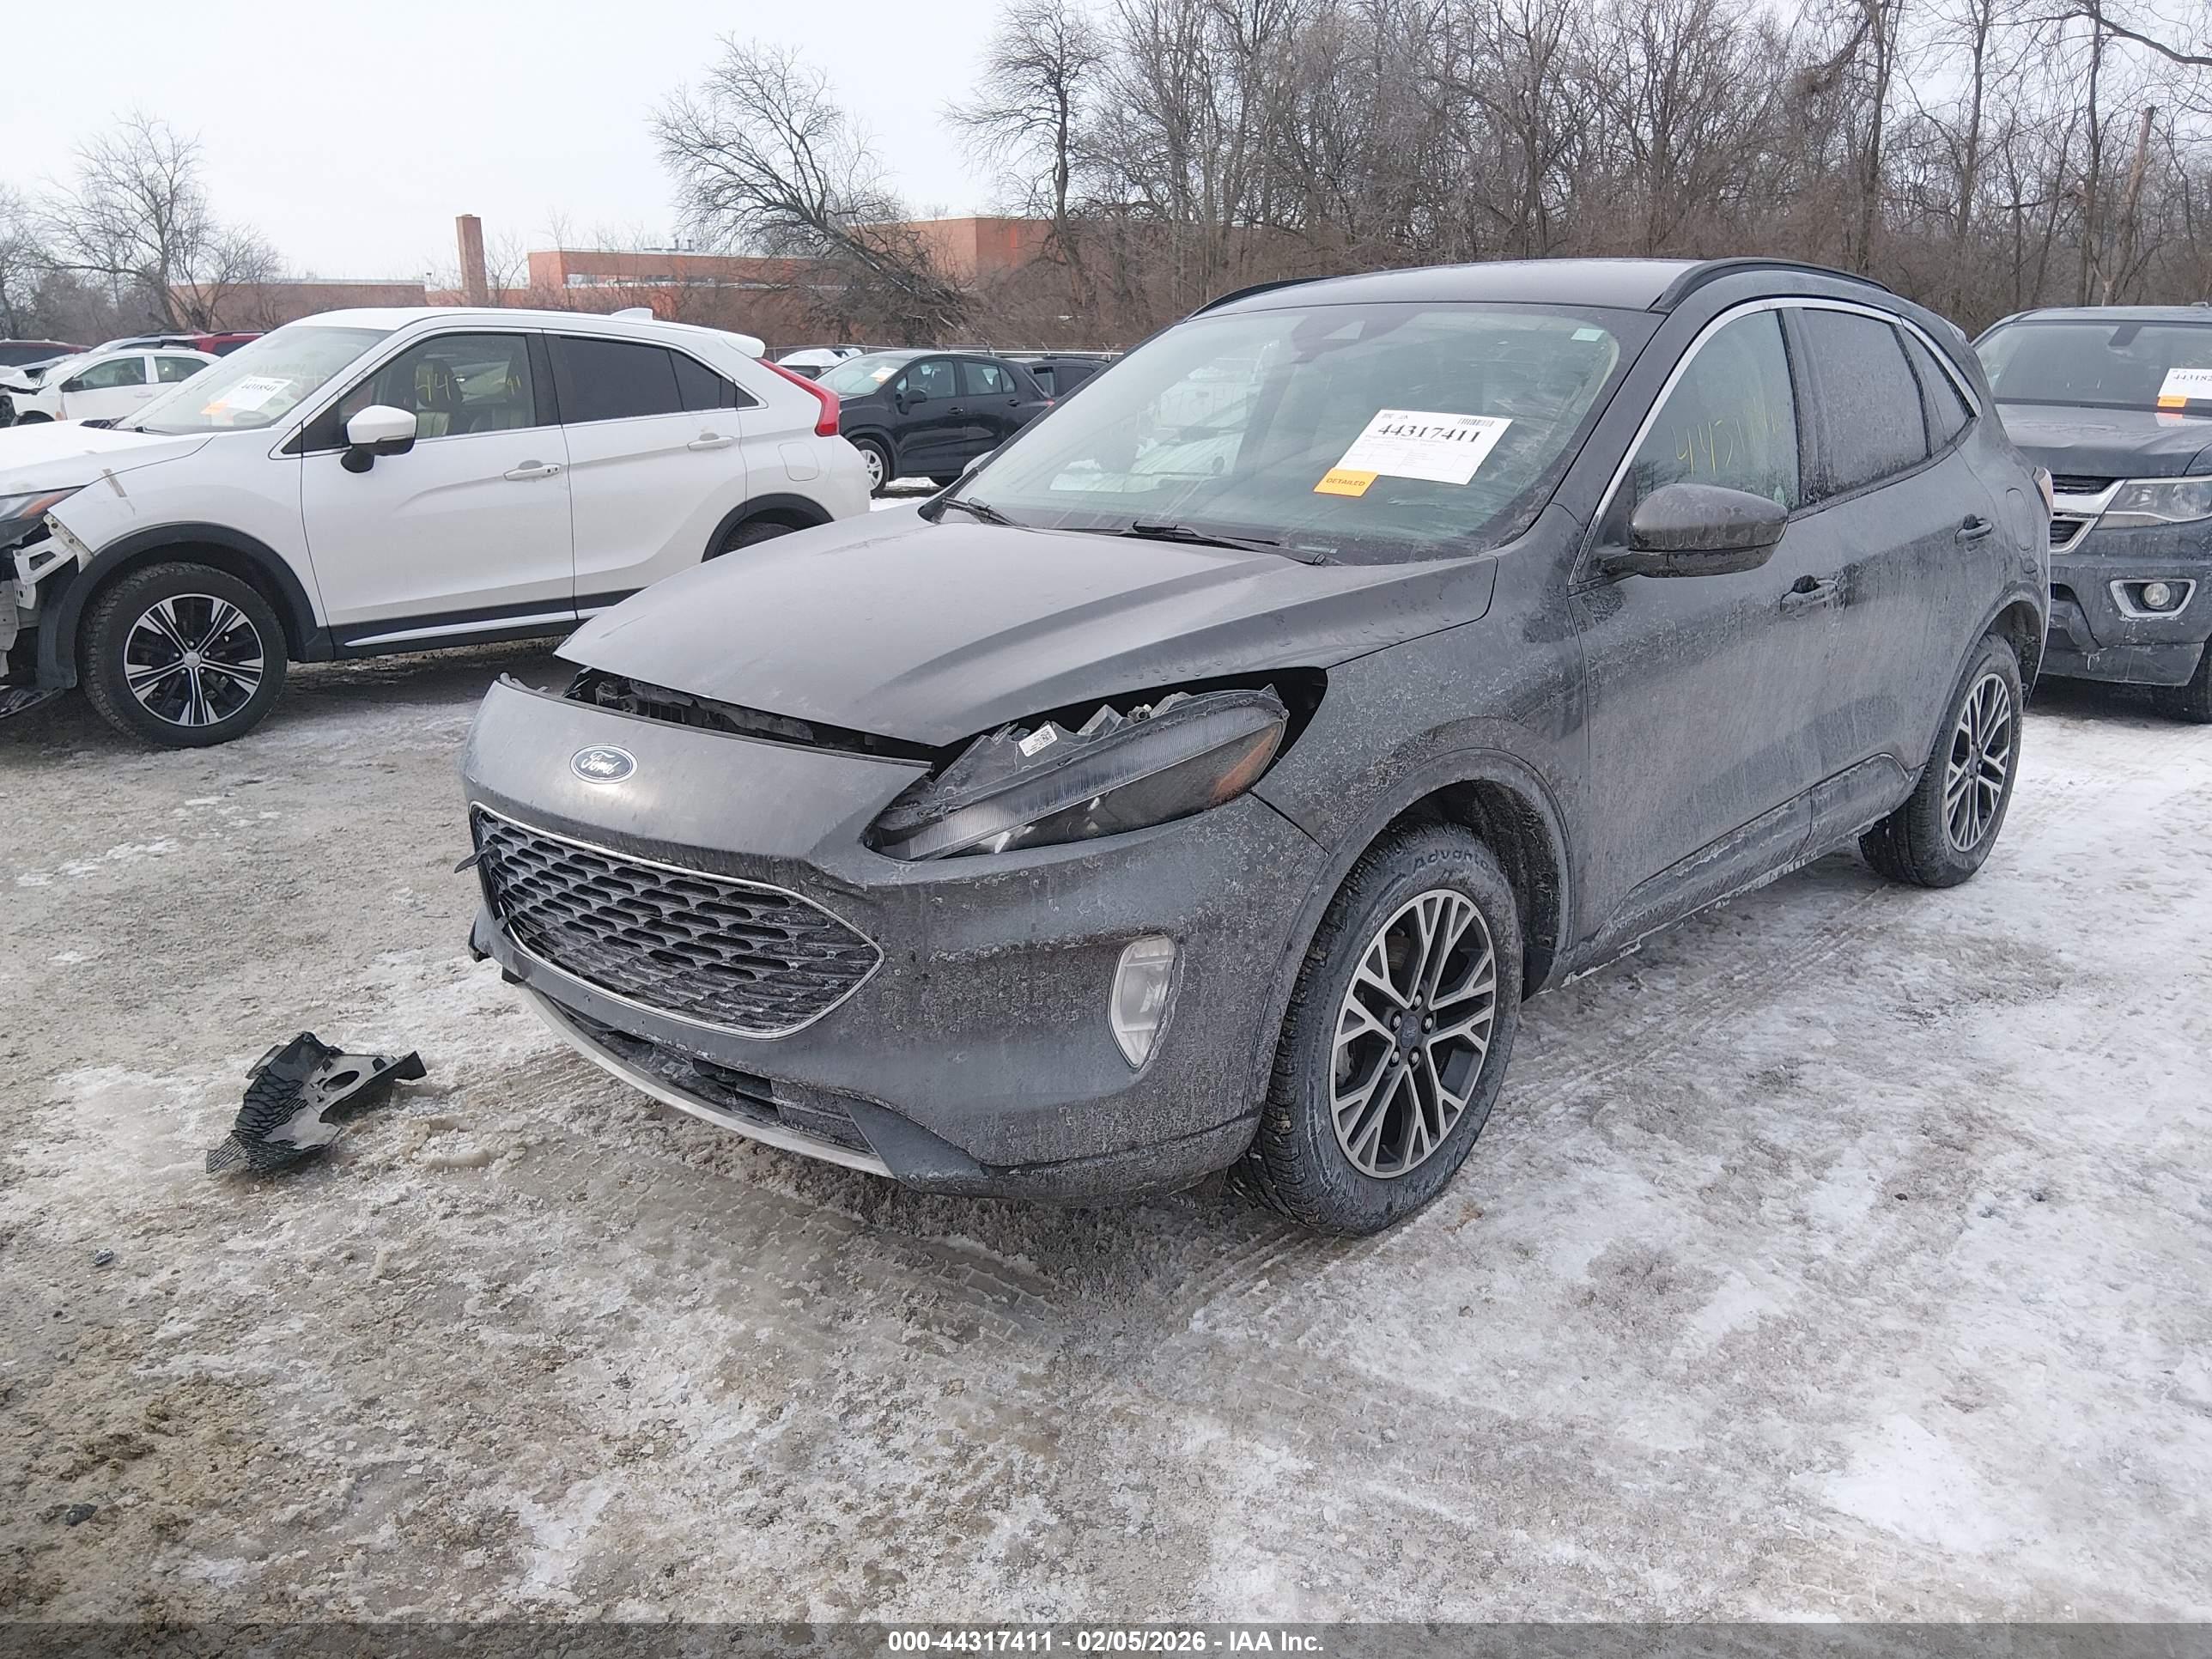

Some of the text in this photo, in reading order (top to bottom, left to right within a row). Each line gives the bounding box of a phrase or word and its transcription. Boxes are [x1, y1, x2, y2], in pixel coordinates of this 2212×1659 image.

[1376, 423, 1482, 444] 44317411
[1325, 477, 1367, 488] DETAILED
[580, 750, 621, 775] Ford
